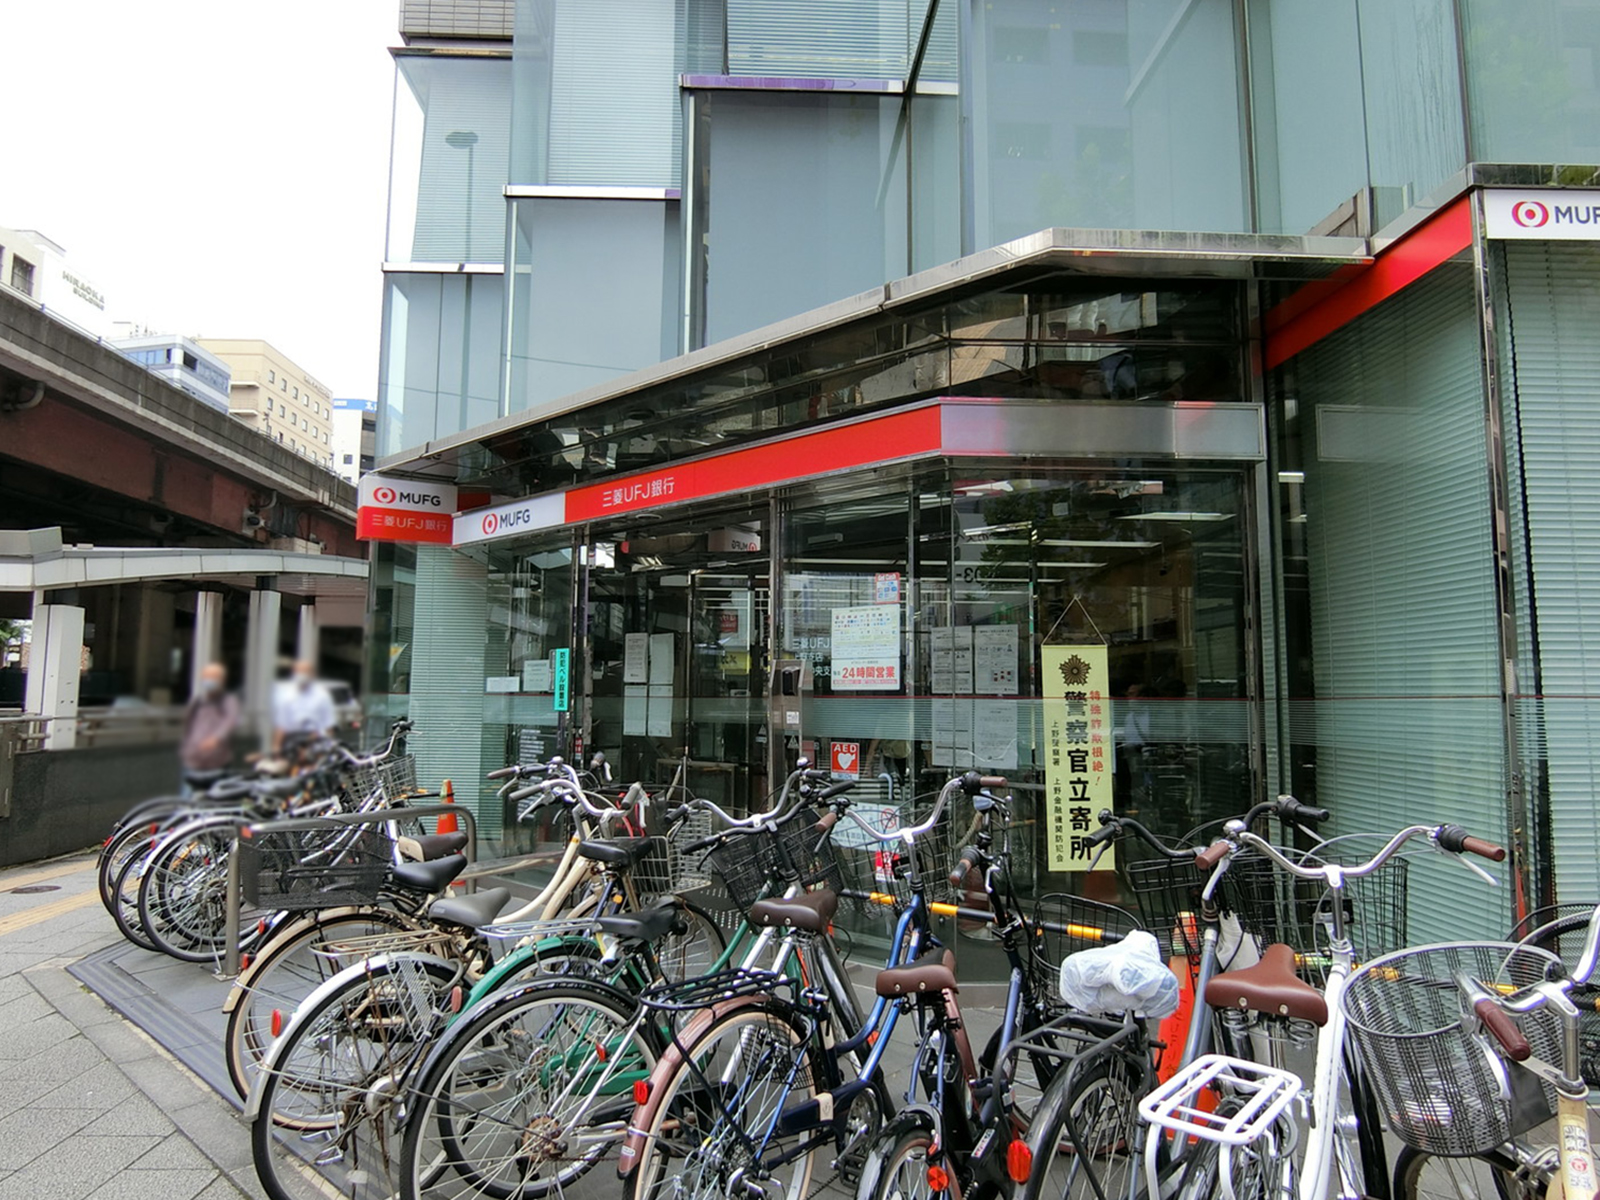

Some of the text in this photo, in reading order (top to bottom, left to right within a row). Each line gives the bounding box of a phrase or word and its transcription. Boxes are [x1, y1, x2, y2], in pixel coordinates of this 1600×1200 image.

[62, 270, 105, 304] HIRAOKA
[399, 492, 441, 506] MUFG
[602, 476, 676, 508] 三菱UFJ銀行
[372, 514, 448, 532] 三菱UFJ銀行
[499, 509, 531, 529] MUFG
[842, 665, 895, 679] 24時間営業
[833, 744, 857, 753] AED
[1064, 690, 1092, 861] 警察官立寄所
